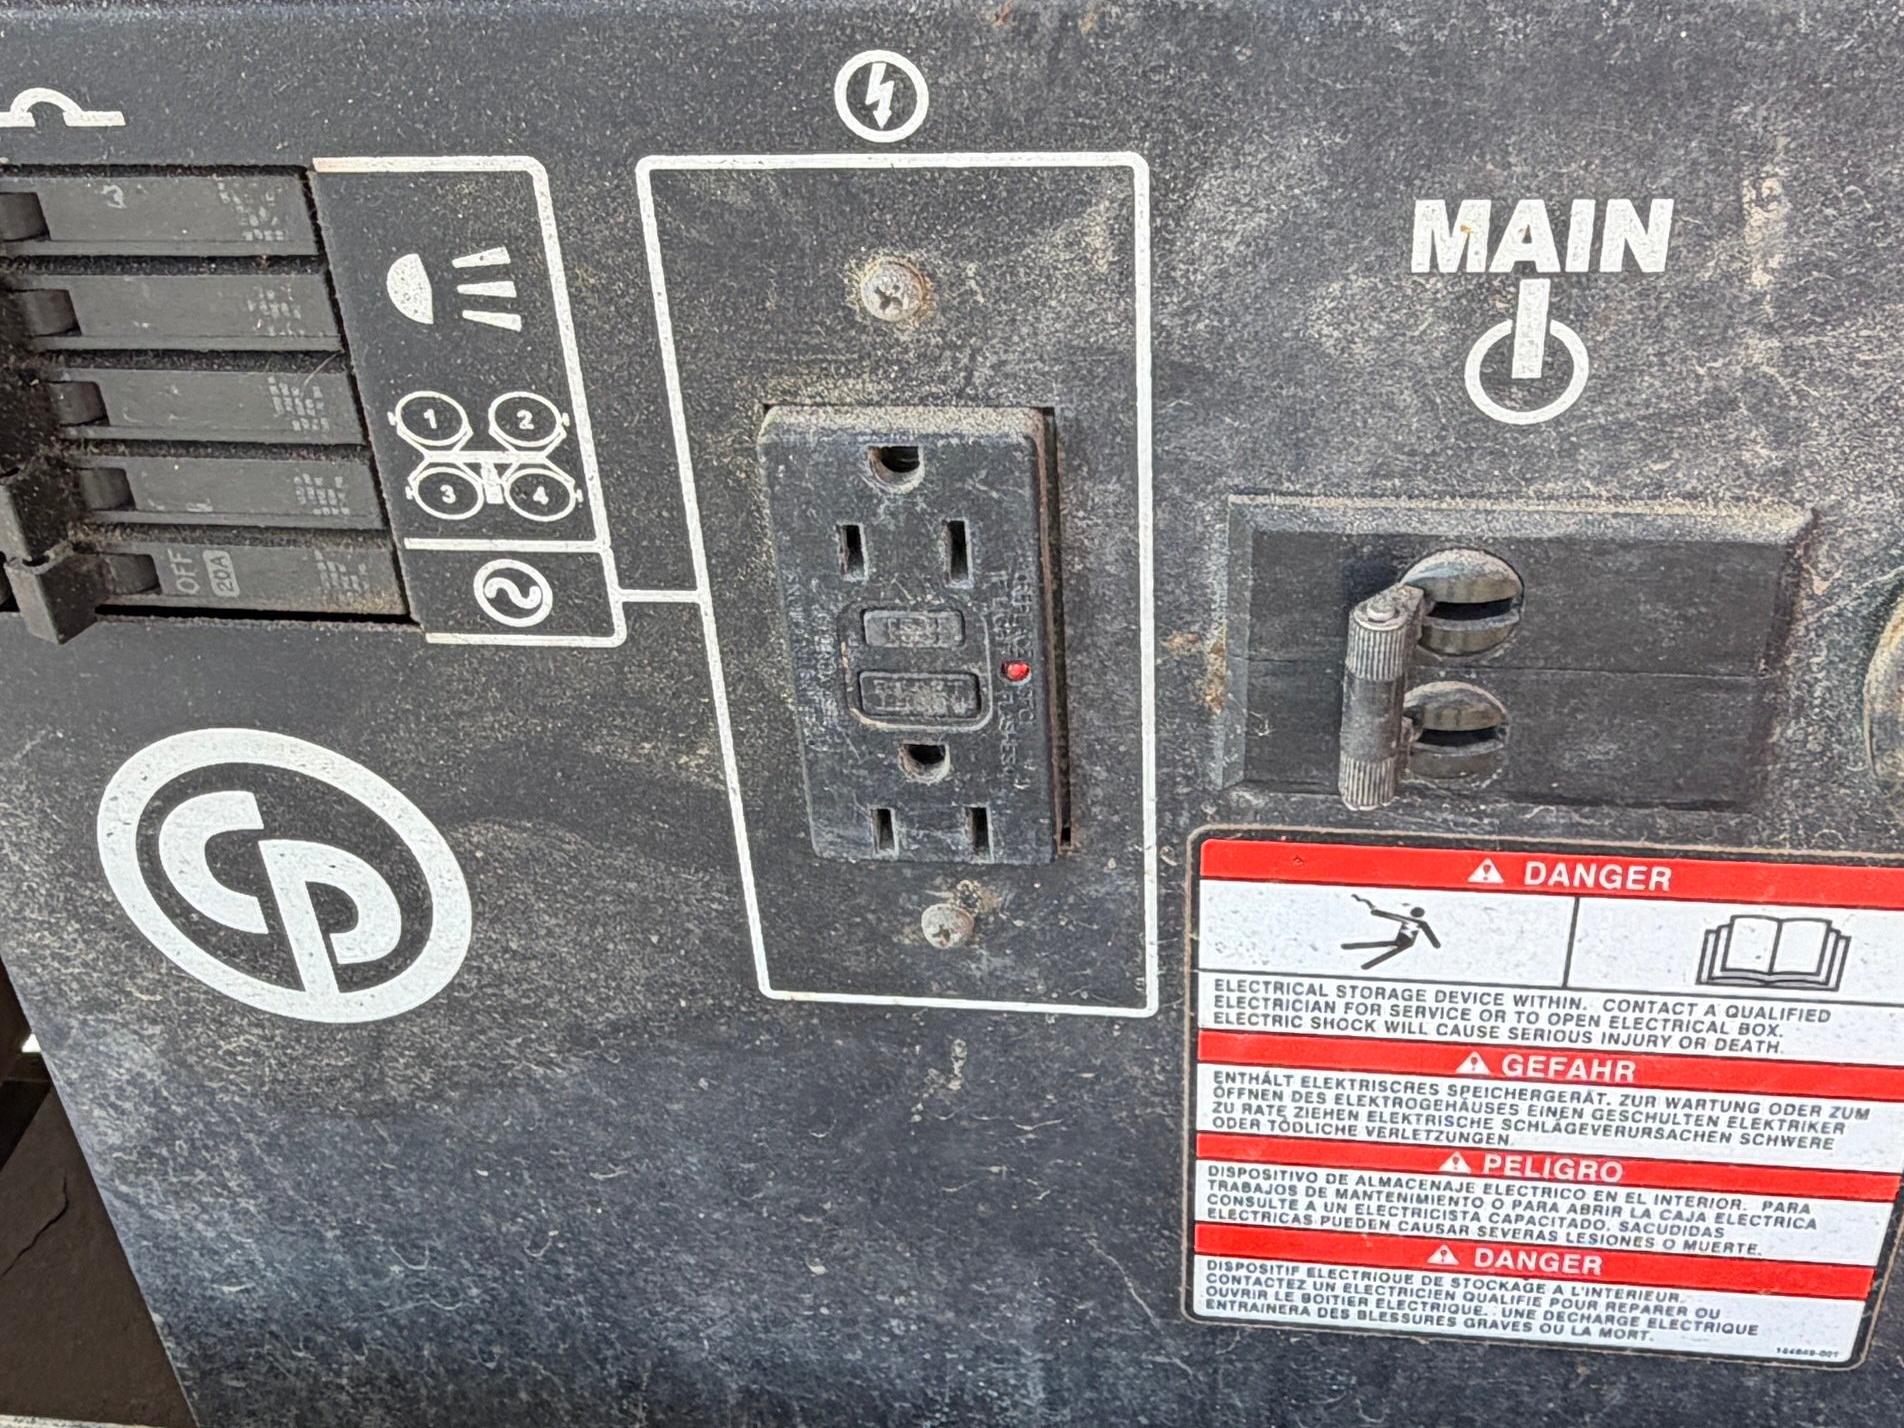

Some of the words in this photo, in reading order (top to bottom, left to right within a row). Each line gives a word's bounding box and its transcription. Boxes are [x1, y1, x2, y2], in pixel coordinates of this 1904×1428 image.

[1409, 197, 1675, 273] MAIN
[423, 408, 438, 429] 1
[516, 409, 535, 430] 2
[440, 484, 457, 504] 3
[532, 485, 550, 505] 4
[167, 549, 199, 595] OFF
[209, 555, 236, 593] 20A
[1523, 862, 1673, 892] DANGER
[1214, 979, 1327, 998] ELECTRICAL
[1336, 985, 1424, 1003] STORAGE
[1434, 990, 1503, 1007] DEVICE
[1512, 993, 1587, 1011] WITHIN.
[1602, 998, 1694, 1016] CONTACT
[1704, 1003, 1715, 1017] A
[1725, 1004, 1830, 1023] QUALIFIED
[1214, 995, 1335, 1016] ELECTRICIAN
[1344, 1002, 1381, 1018] FOR
[1389, 1004, 1470, 1023] SERVICE
[1479, 1009, 1506, 1024] OR
[1516, 1010, 1538, 1026] TO
[1548, 1012, 1600, 1029] OPEN
[1608, 1015, 1726, 1035] ELECTRICAL
[1738, 1021, 1783, 1038] BOX.
[1212, 1011, 1303, 1030] ELECTRIC
[1310, 1016, 1376, 1034] SHOCK
[1383, 1020, 1428, 1036] WILL
[1434, 1022, 1500, 1040] CAUSE
[1506, 1026, 1592, 1045] SERIOUS
[1600, 1031, 1672, 1049] INJURY
[1678, 1034, 1706, 1051] OR
[1501, 1055, 1637, 1083] GEFAHR
[1210, 1102, 1234, 1116] ZU
[1240, 1103, 1288, 1119] RATE
[1292, 1106, 1360, 1123] ZIEHEN
[1366, 1110, 1494, 1131] ELEKTRISCHE
[1738, 1132, 1834, 1151] SCHWERE
[1212, 1117, 1259, 1133] ODER
[1290, 1091, 1326, 1106] DES
[1526, 1104, 1584, 1121] EINEN
[1590, 1108, 1720, 1129] GESCHULTEN
[1726, 1115, 1846, 1136] ELEKTRIKER
[1619, 1093, 1656, 1110] ZUR
[1666, 1096, 1759, 1116] WARTUNG
[1769, 1102, 1821, 1119] ODER
[1830, 1105, 1869, 1122] ZUM
[1207, 1164, 1318, 1185] DISPOSITIVO
[1324, 1171, 1348, 1187] DE
[1354, 1173, 1474, 1195] ALMACENAJE
[1482, 1181, 1586, 1201] ELECTRICO
[1592, 1188, 1618, 1203] EN
[1624, 1190, 1646, 1205] EL
[1653, 1191, 1746, 1211] INTERIOR.
[1760, 1198, 1810, 1215] PARA
[1483, 1156, 1624, 1183] PELIGRO
[1206, 1193, 1298, 1212] CONSULTE
[1304, 1199, 1316, 1213] A
[1323, 1200, 1346, 1215] UN
[1354, 1202, 1480, 1224] ELECTRICISTA
[1618, 1219, 1724, 1239] SACUDIDAS
[1209, 1179, 1297, 1198] TRABAJOS
[1304, 1185, 1326, 1199] DE
[1335, 1187, 1484, 1209] MANTENIMIENTO
[1491, 1197, 1504, 1211] O
[1511, 1198, 1558, 1214] PARA
[1566, 1201, 1622, 1218] ABRIR
[1630, 1205, 1650, 1220] LA
[1659, 1207, 1706, 1223] CAJA
[1714, 1210, 1816, 1230] ELECTRICA
[1206, 1207, 1317, 1227] ELECTRICAS
[1319, 1214, 1390, 1231] PUEDEN
[1396, 1219, 1470, 1237] CAUSAR
[1476, 1224, 1558, 1243] SEVERAS
[1564, 1230, 1655, 1249] LESIONES
[1661, 1236, 1676, 1250] O
[1682, 1237, 1762, 1256] MUERTE.
[1206, 1259, 1300, 1278] DISPOSITIF
[1306, 1266, 1414, 1286] ELECTRIQUE
[1420, 1273, 1444, 1288] DE
[1449, 1275, 1546, 1295] STOCKAGE
[1551, 1282, 1564, 1296] A
[1474, 1247, 1603, 1275] DANGER
[1204, 1286, 1268, 1303] OUVRIR
[1274, 1290, 1294, 1305] LE
[1300, 1292, 1368, 1310] BOITIER
[1500, 1306, 1536, 1321] UNE
[1542, 1308, 1640, 1329] DECHARGE
[1646, 1315, 1759, 1337] ELECTRIQUE
[1206, 1273, 1305, 1292] CONTACTEZ
[1312, 1280, 1335, 1294] UN
[1342, 1282, 1455, 1302] ELECTRICIEN
[1462, 1290, 1540, 1308] QUALIFIE
[1549, 1296, 1597, 1312] POUR
[1605, 1299, 1687, 1318] REPARER
[1695, 1305, 1720, 1320] OU
[1205, 1298, 1310, 1318] ENTRAINERA
[1316, 1306, 1350, 1321] DES
[1356, 1308, 1456, 1328] BLESSURES
[1462, 1316, 1532, 1333] GRAVES
[1538, 1321, 1564, 1336] OU
[1570, 1323, 1592, 1338] LA
[1598, 1325, 1652, 1342] MORT.
